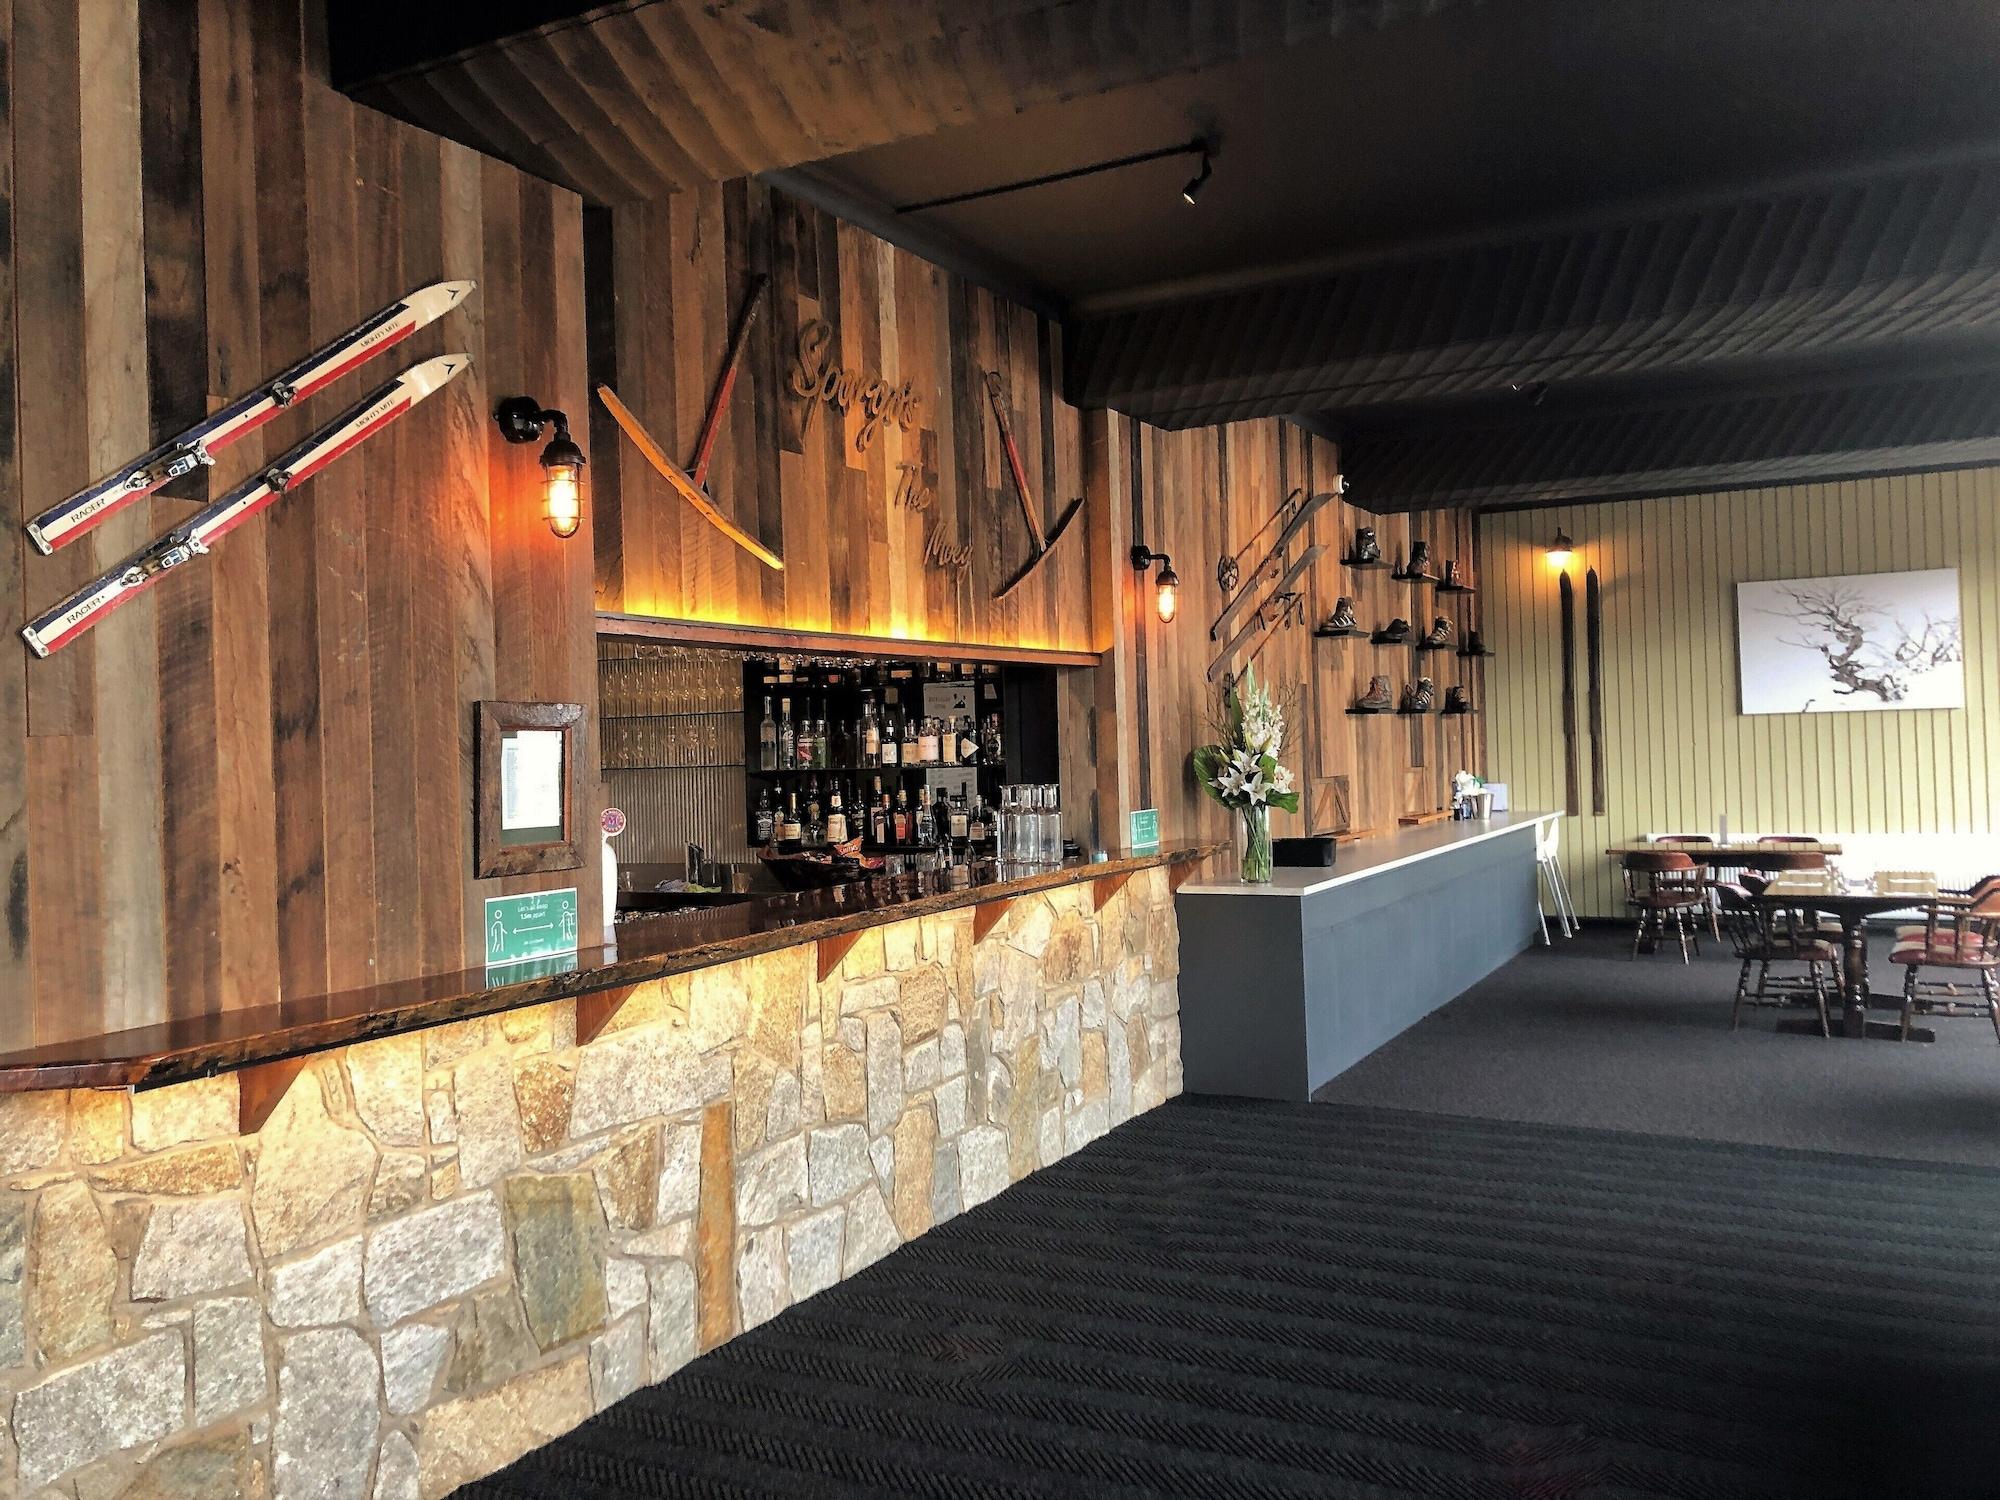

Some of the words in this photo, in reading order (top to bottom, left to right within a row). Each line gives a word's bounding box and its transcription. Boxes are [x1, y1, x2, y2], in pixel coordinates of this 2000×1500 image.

[893, 462, 931, 514] The
[71, 498, 105, 523] RACER
[66, 597, 101, 624] RACER
